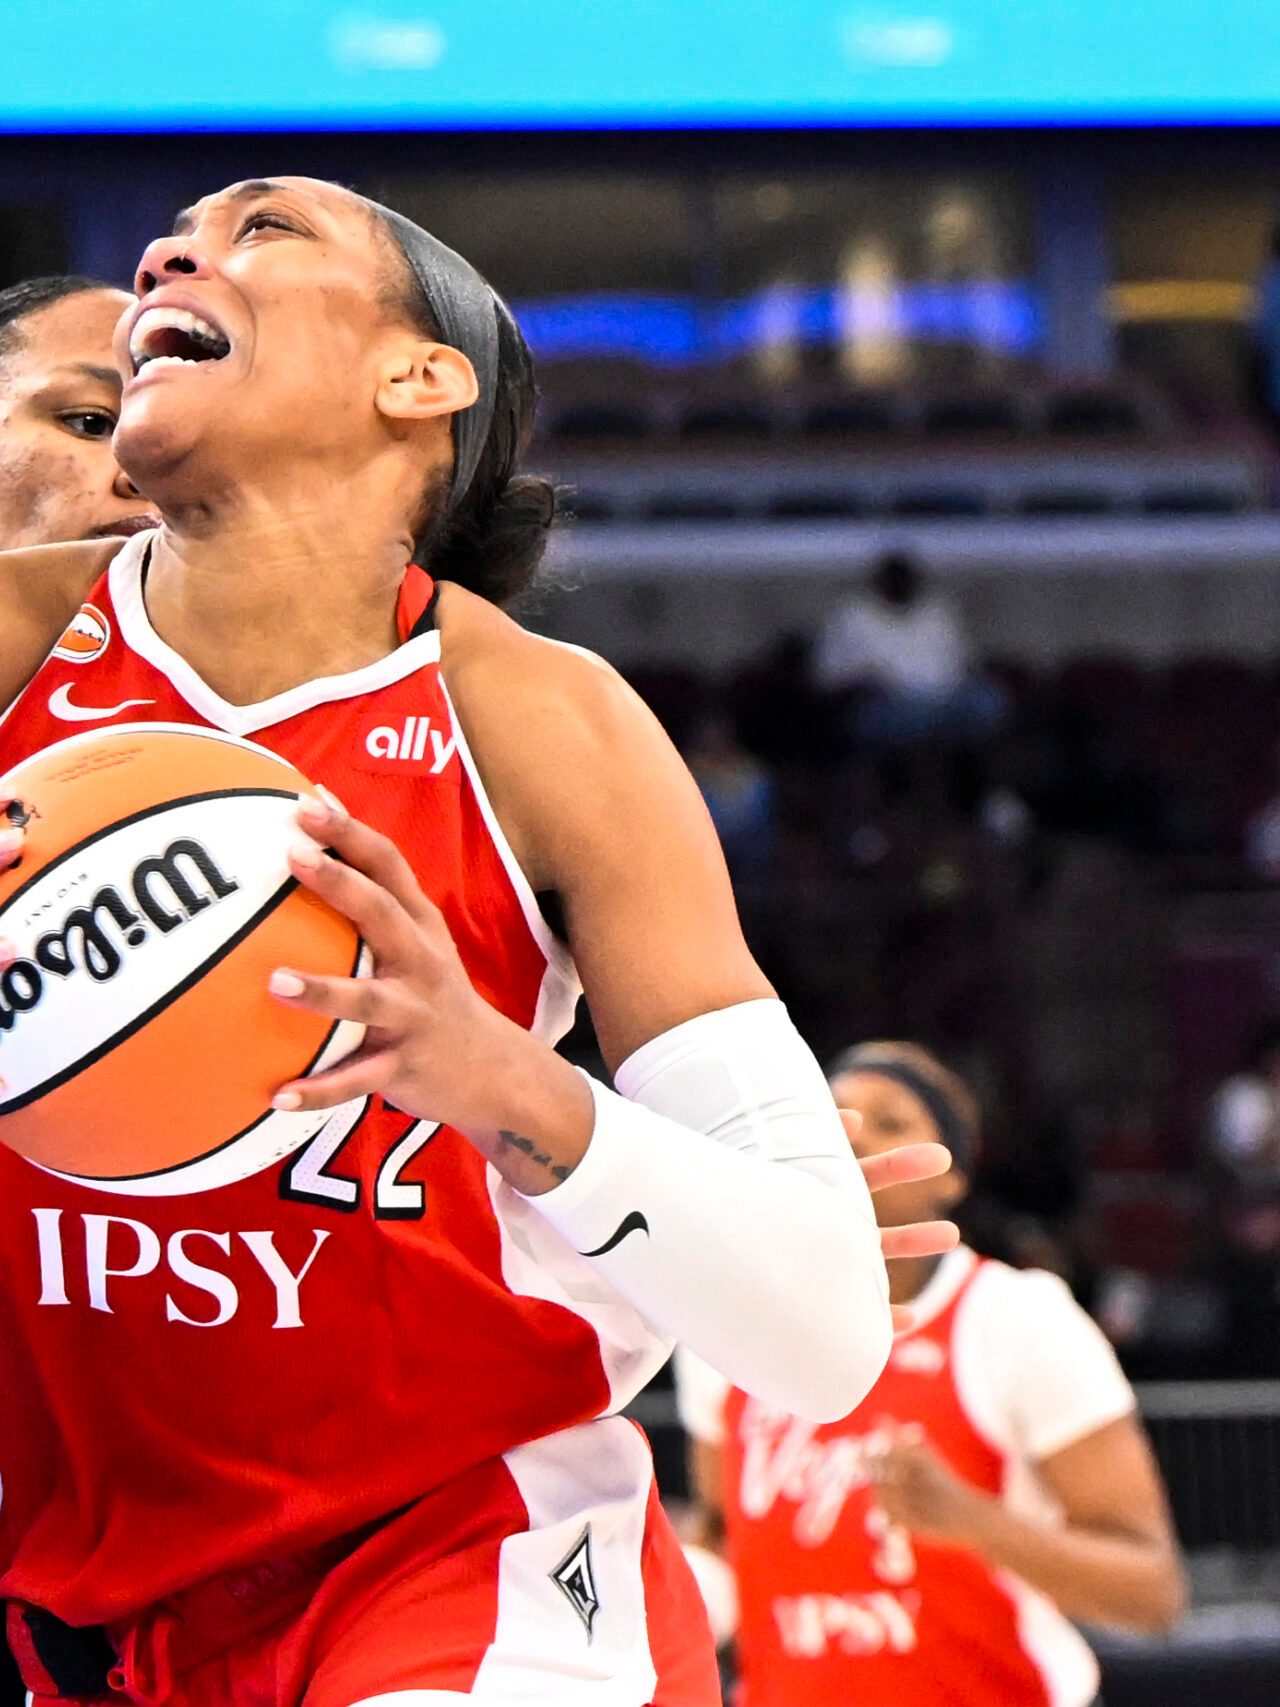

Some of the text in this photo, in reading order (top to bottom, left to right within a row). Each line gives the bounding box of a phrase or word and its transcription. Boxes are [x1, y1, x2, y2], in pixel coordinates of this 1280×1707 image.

[365, 715, 456, 775] ally
[278, 1093, 441, 1222] 22
[32, 1207, 333, 1330] IPSY
[738, 1392, 926, 1549] Veg
